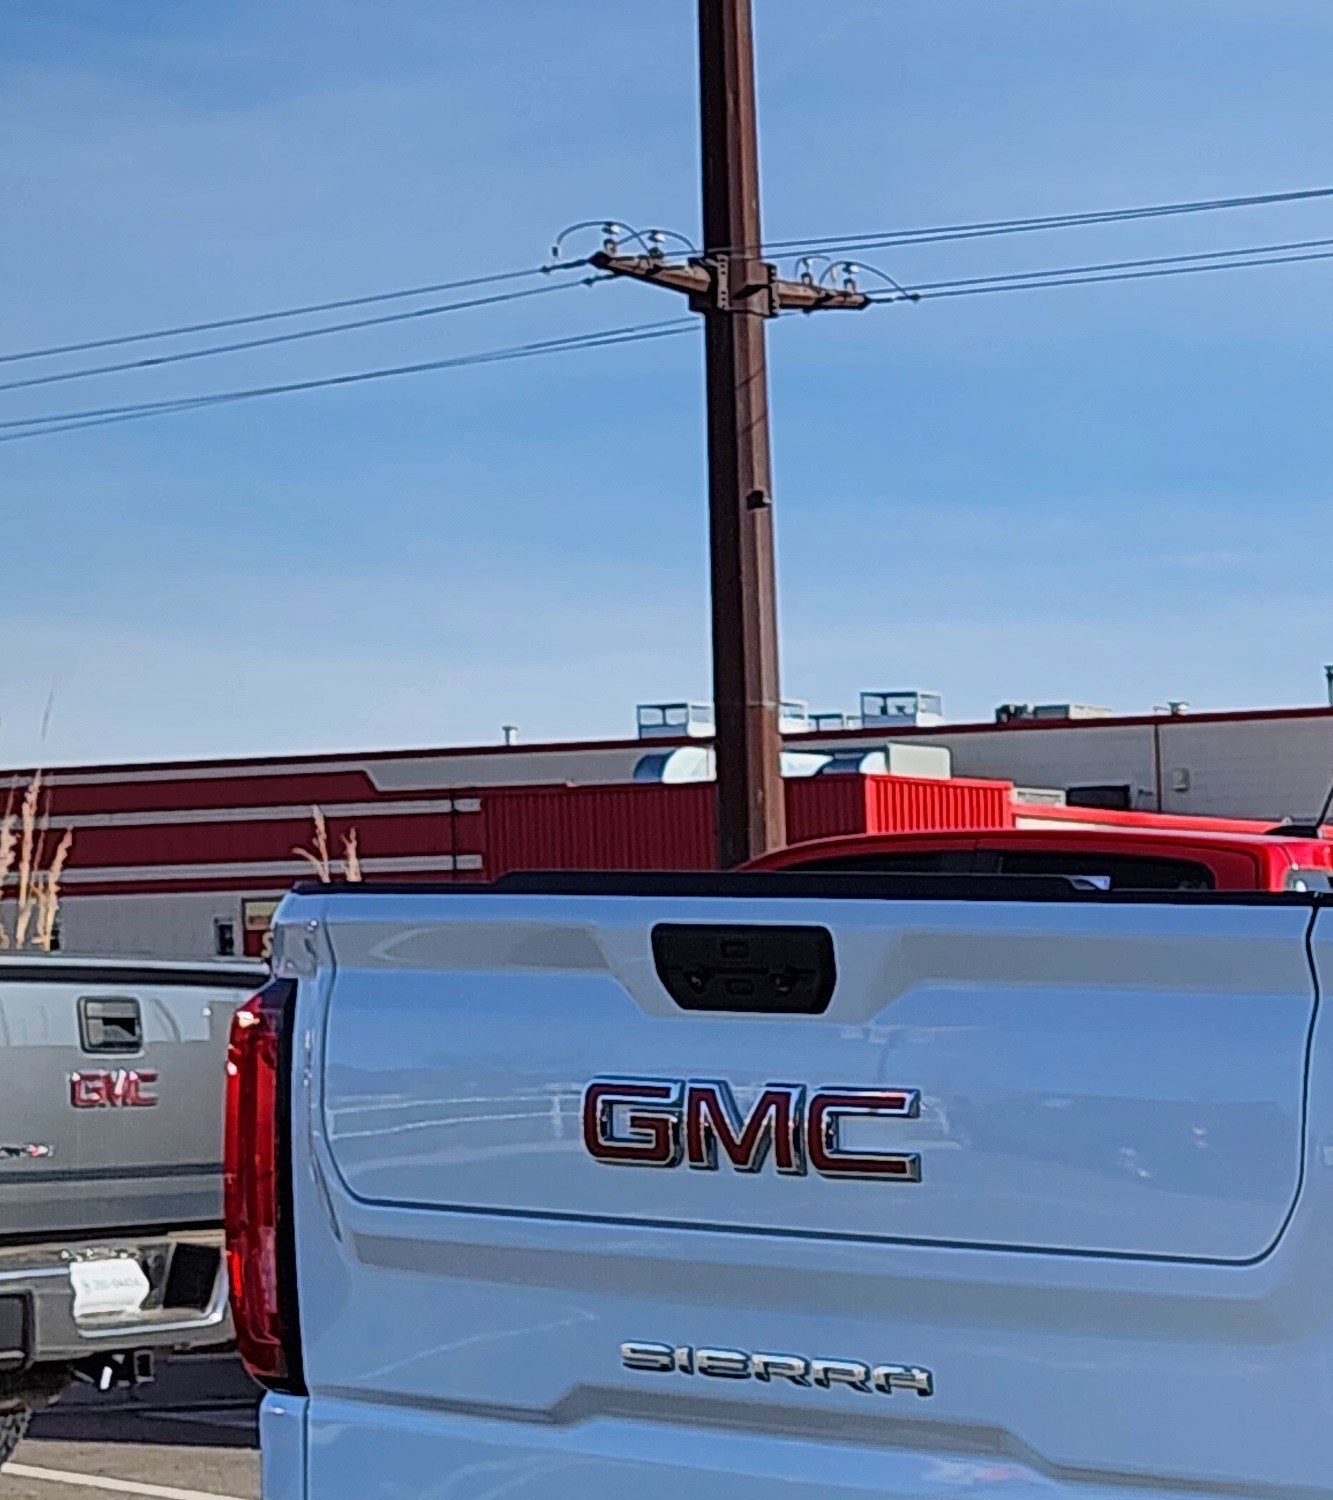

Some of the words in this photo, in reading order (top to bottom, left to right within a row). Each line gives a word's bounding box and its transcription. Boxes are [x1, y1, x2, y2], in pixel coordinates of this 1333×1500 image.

[69, 1068, 160, 1108] GMC
[583, 1075, 922, 1183] GMC
[620, 1339, 934, 1397] SIERRA
